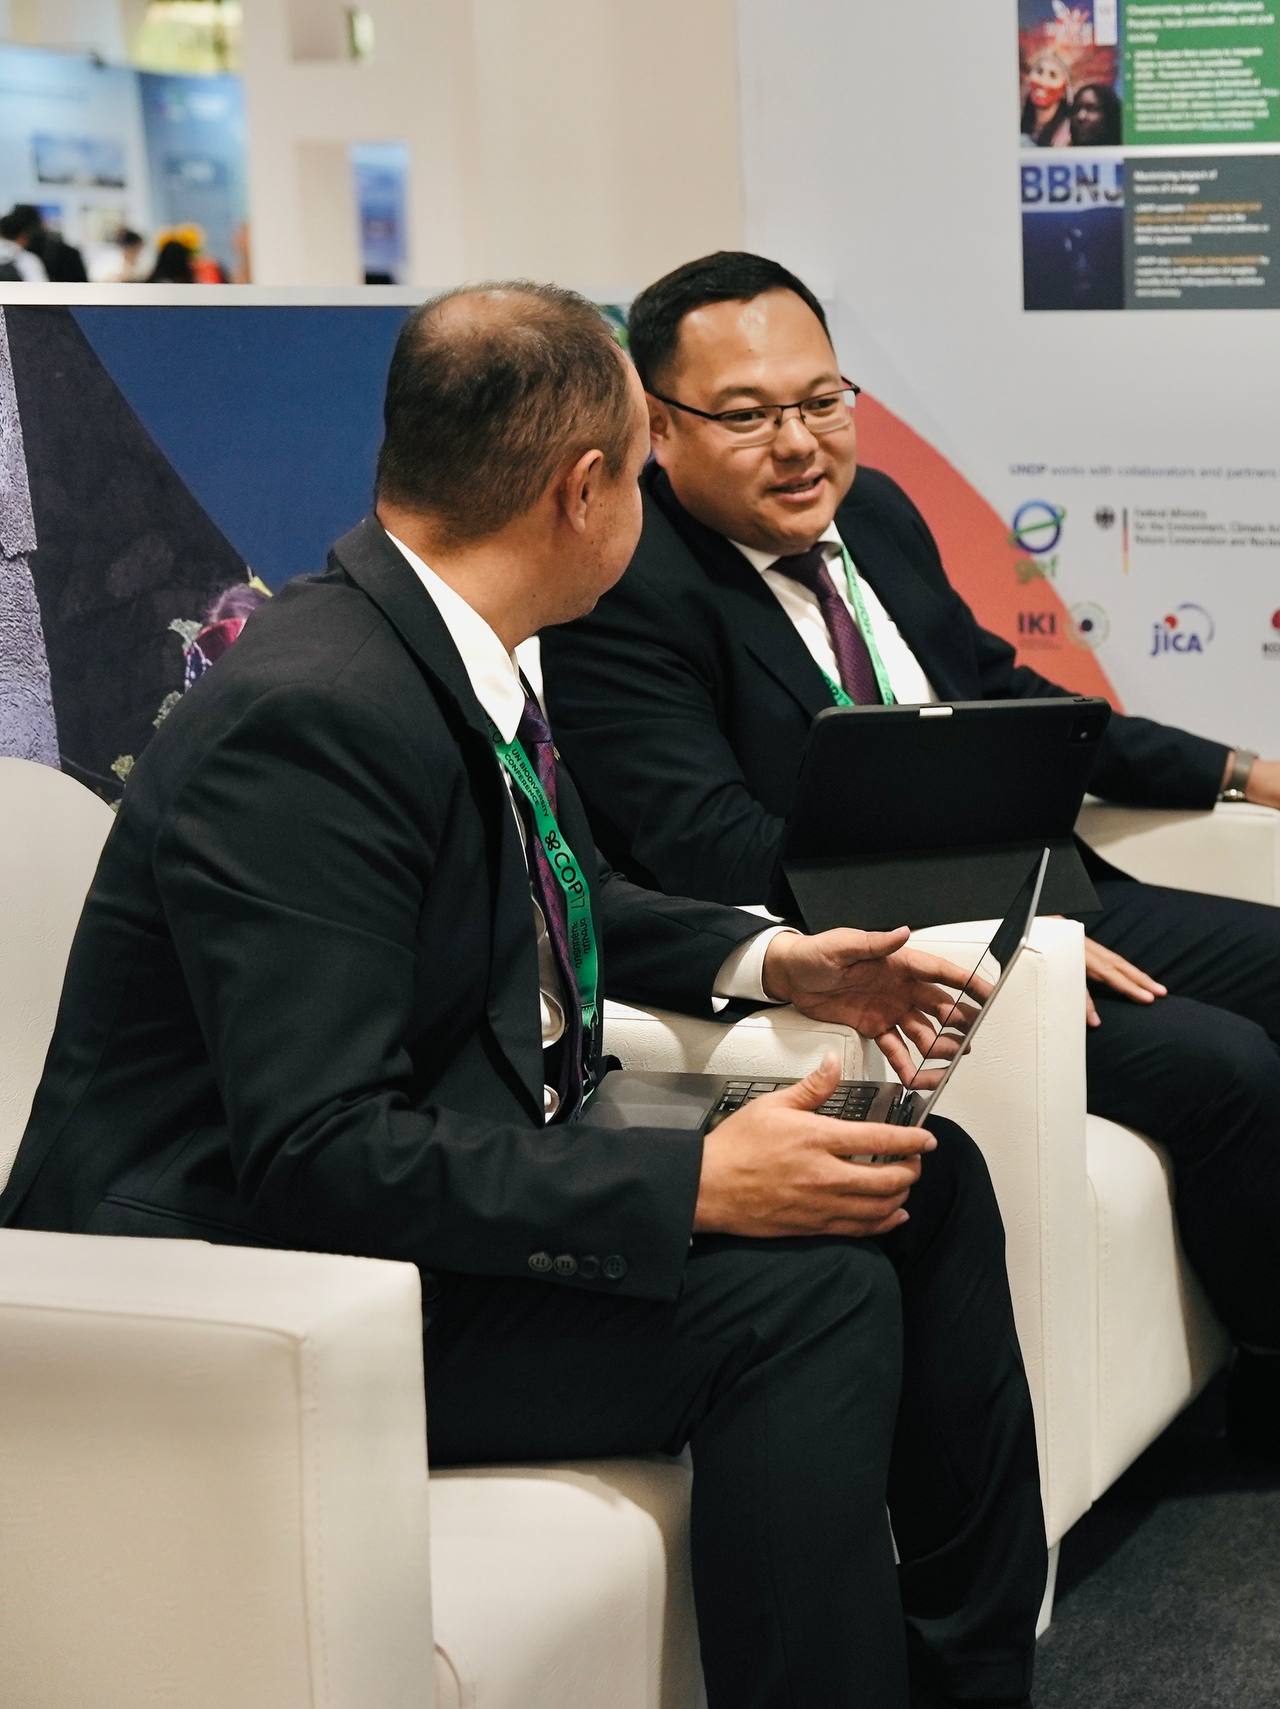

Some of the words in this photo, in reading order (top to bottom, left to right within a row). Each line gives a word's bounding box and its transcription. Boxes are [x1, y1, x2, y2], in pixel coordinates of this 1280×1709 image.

[1009, 464, 1048, 476] UNDP
[1051, 465, 1087, 477] works
[1090, 465, 1113, 477] with
[1118, 466, 1196, 479] collaborators
[1200, 467, 1222, 479] and
[1226, 468, 1277, 481] partners
[1018, 612, 1057, 635] IKI
[504, 753, 541, 807] CONFERENCE
[511, 748, 521, 762] UN
[520, 762, 549, 817] BIODIVERSITY
[554, 852, 586, 909] COP17
